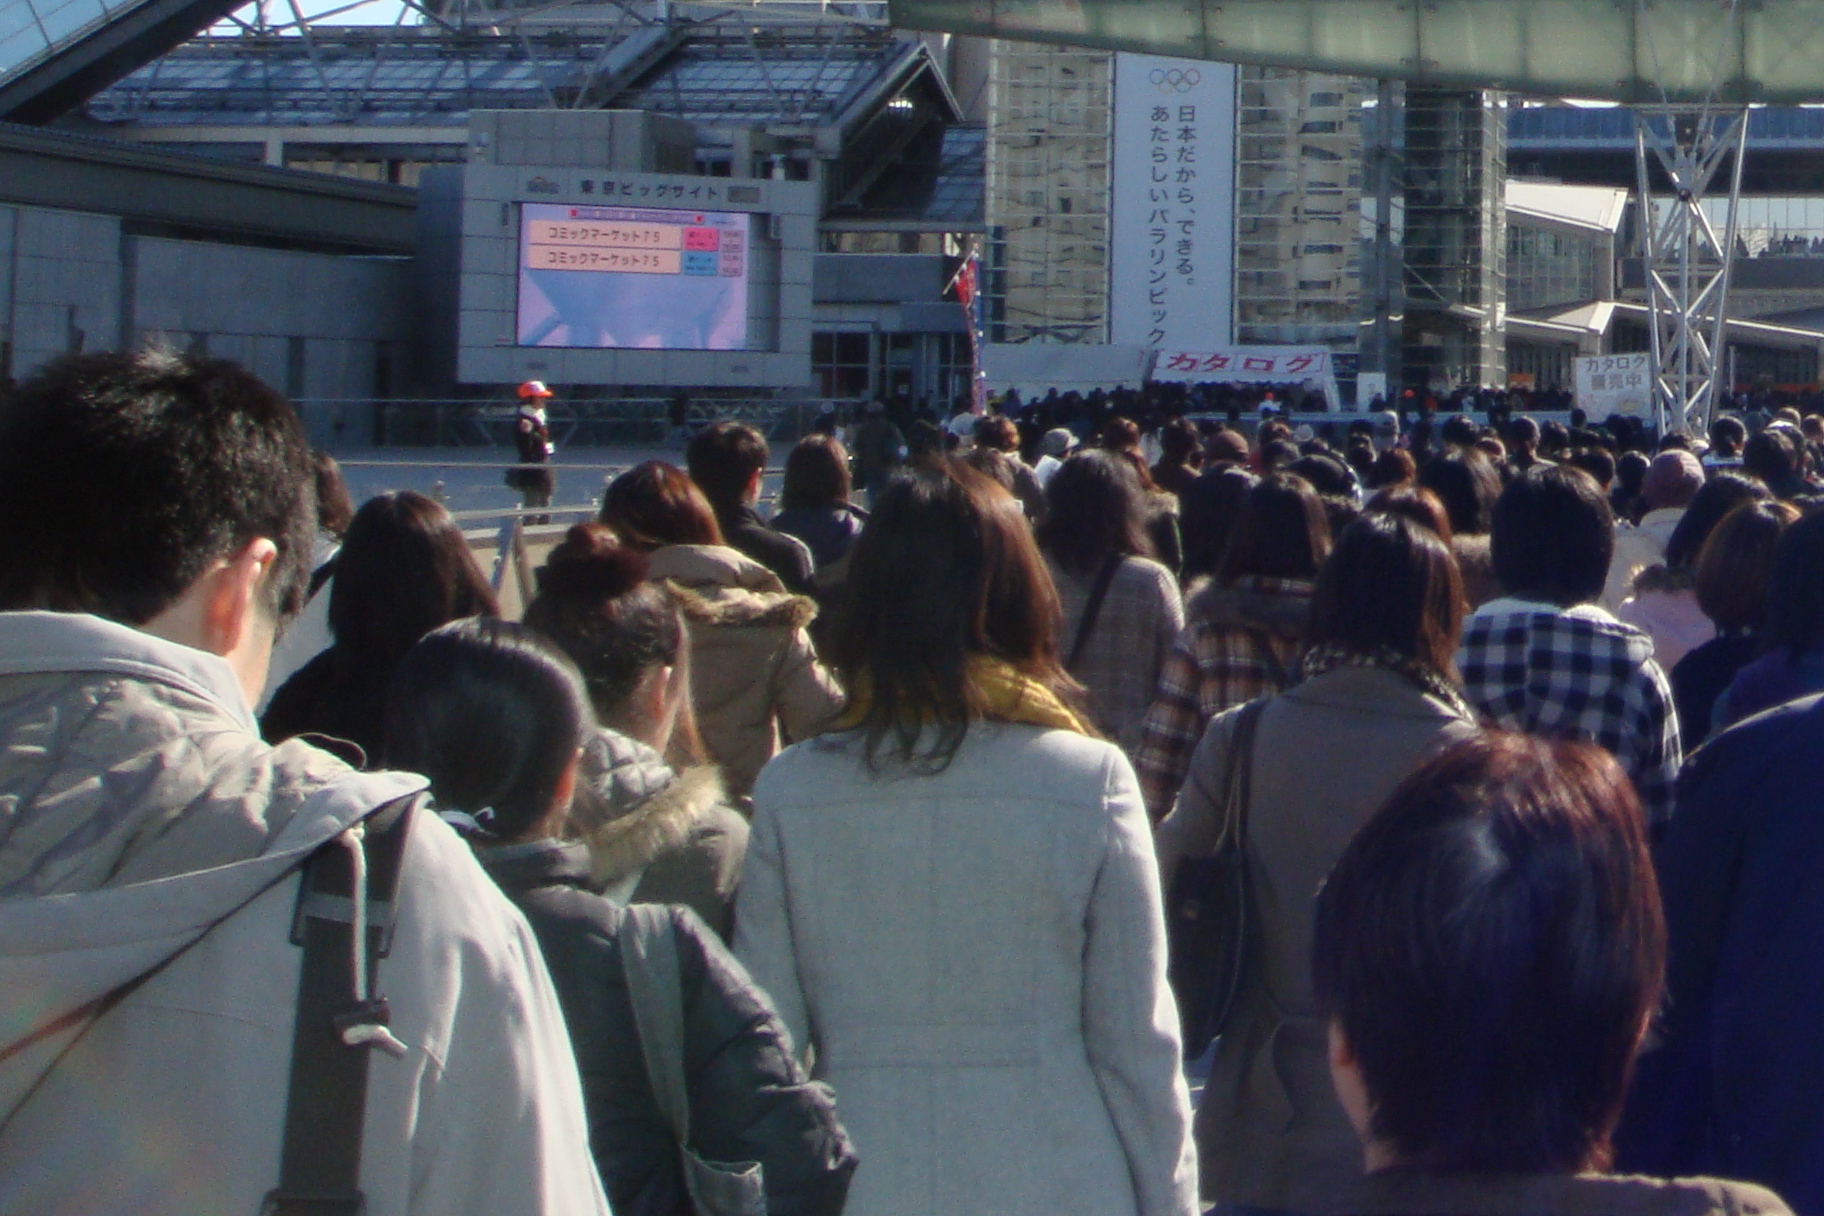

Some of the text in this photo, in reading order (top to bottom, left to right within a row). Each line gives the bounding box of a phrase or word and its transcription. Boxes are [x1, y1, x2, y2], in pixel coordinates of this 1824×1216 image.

[580, 178, 717, 200] 東京ビッグサイト
[1175, 105, 1197, 285] 日本だから、できる。
[1166, 352, 1314, 374] カタログ
